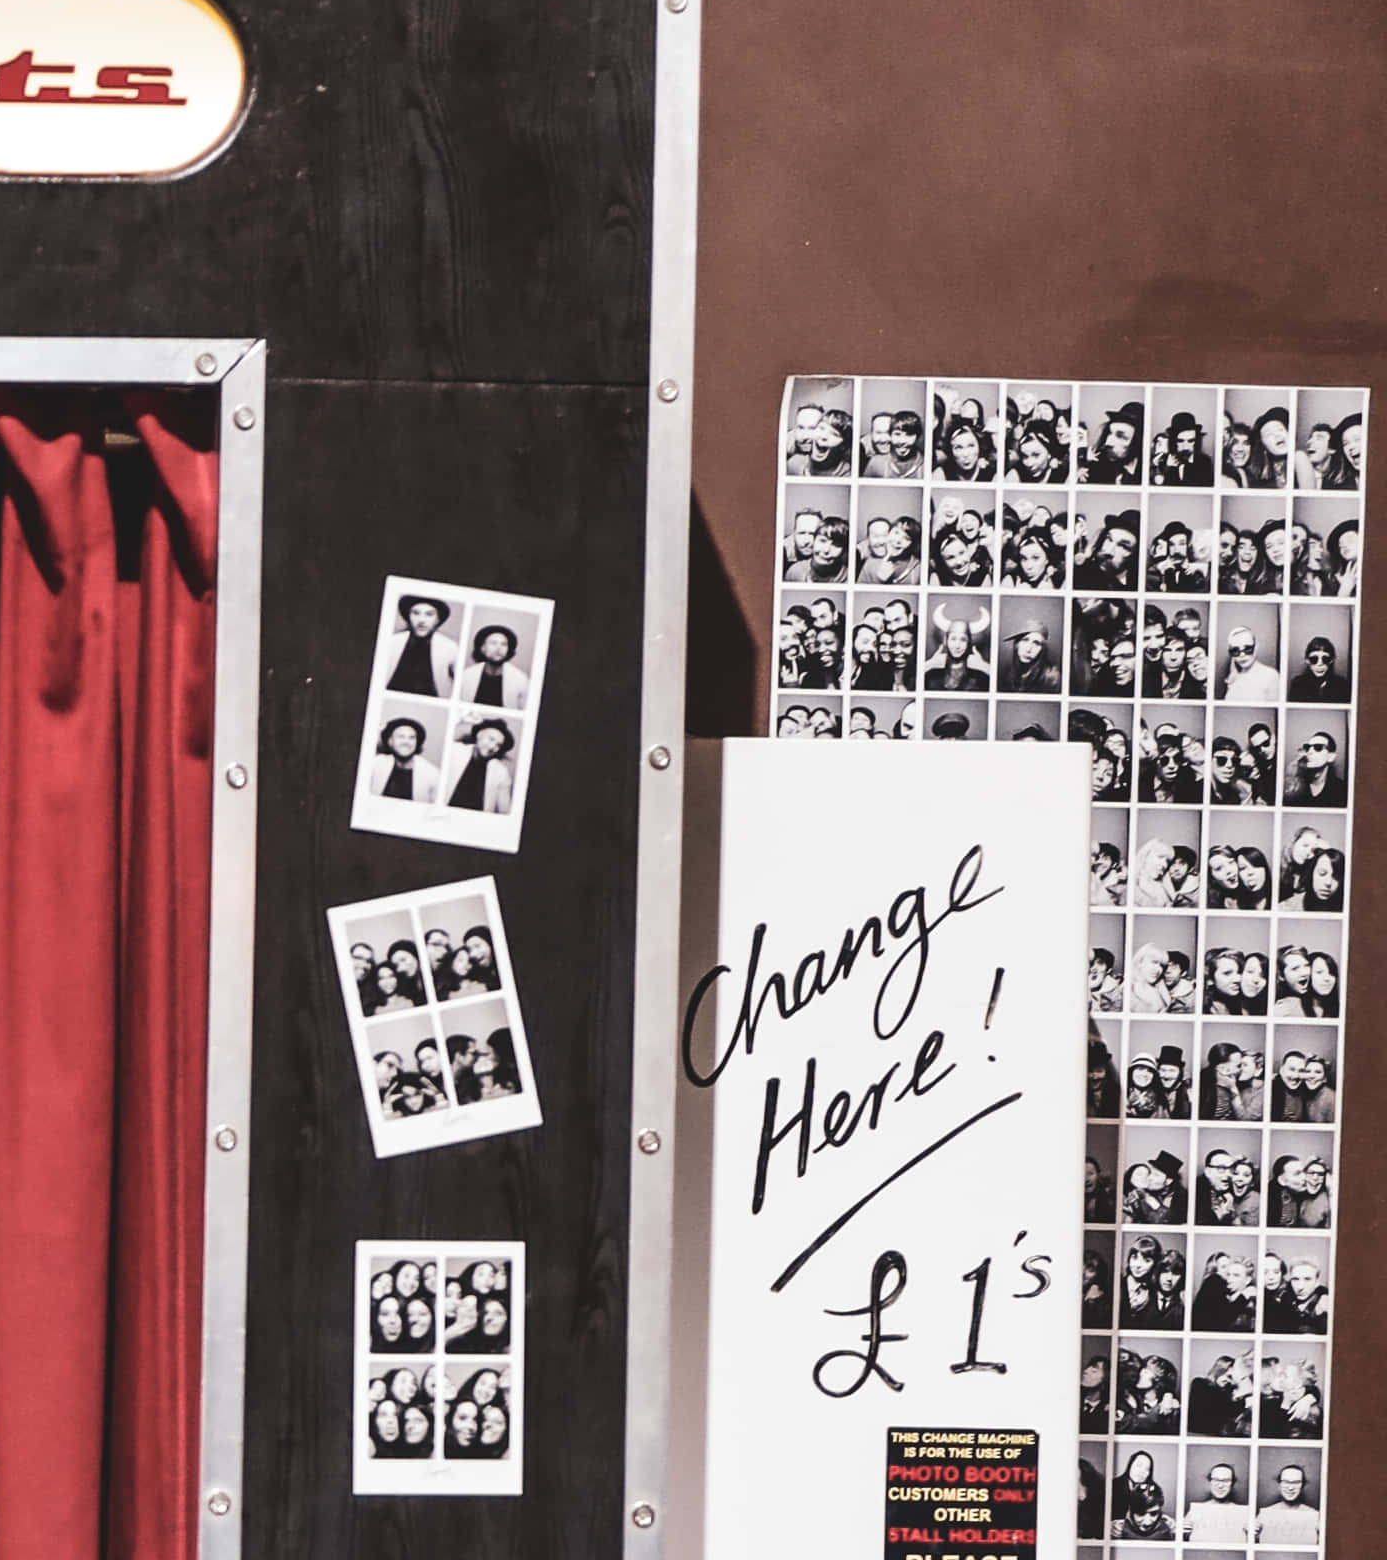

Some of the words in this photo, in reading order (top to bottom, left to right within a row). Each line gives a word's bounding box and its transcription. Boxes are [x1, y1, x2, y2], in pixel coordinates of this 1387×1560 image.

[682, 843, 1005, 1088] Change
[751, 967, 1005, 1215] Here!
[891, 1432, 919, 1443] THIS
[922, 1433, 975, 1444] CHANGE
[977, 1434, 1035, 1445] MACHINE
[904, 1447, 916, 1458] IS
[919, 1447, 945, 1458] FOR
[948, 1448, 973, 1458] THE
[976, 1448, 1001, 1458] USE
[1004, 1449, 1022, 1459] OF
[888, 1465, 959, 1482] PHOTO
[964, 1466, 1036, 1484] BOOTH
[888, 1487, 989, 1502] CUSTOMERS
[993, 1490, 1035, 1502] ONLY
[934, 1508, 992, 1522] OTHER
[888, 1527, 944, 1543] STALL
[948, 1528, 1037, 1545] HOLDERS
